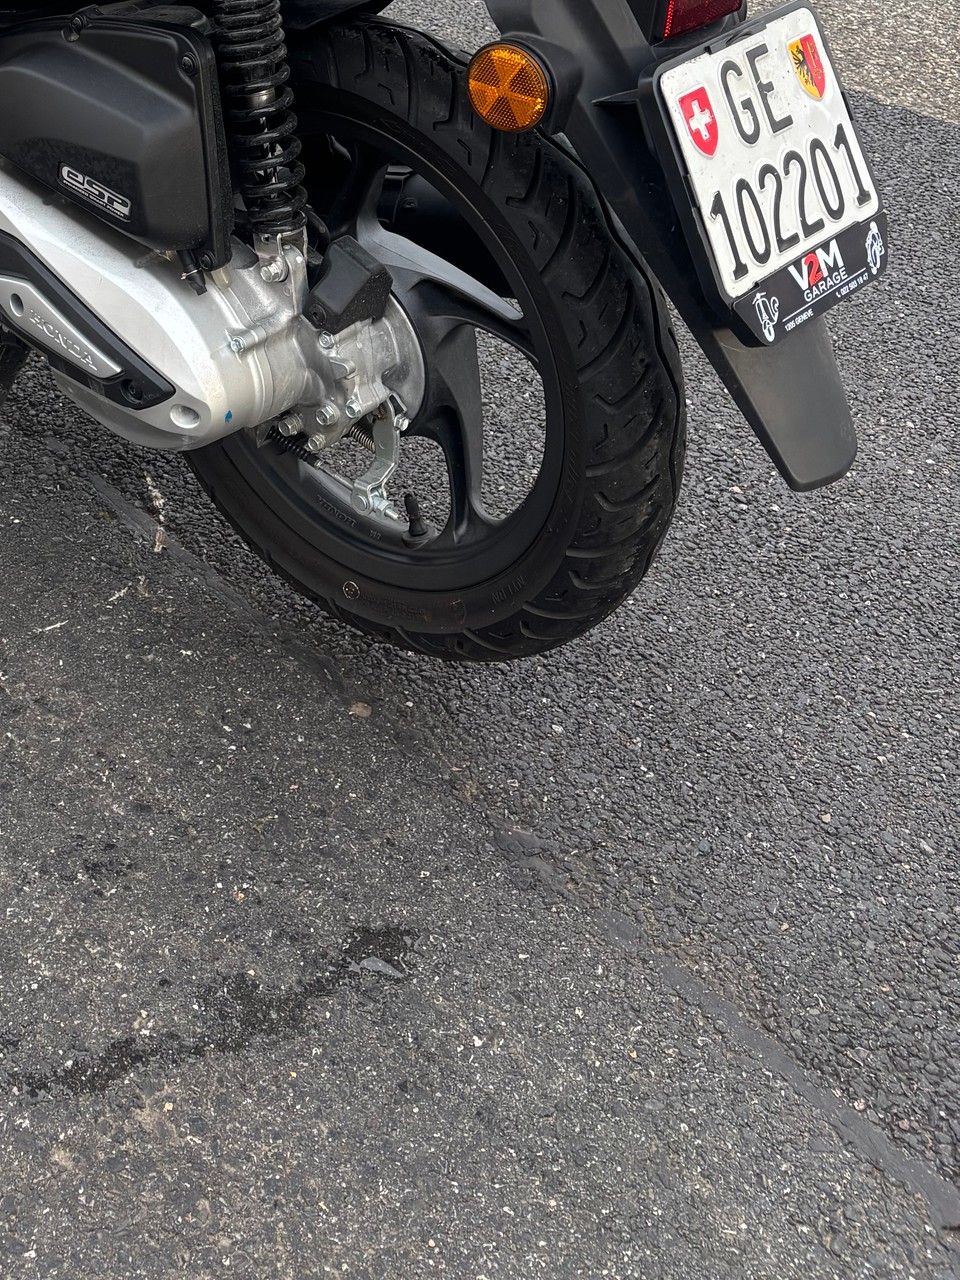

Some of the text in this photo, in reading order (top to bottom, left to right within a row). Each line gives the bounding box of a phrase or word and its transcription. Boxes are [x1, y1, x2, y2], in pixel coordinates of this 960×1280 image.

[720, 42, 794, 145] GE
[710, 123, 872, 281] 102201
[787, 238, 844, 291] V2M
[803, 267, 848, 302] GARAGE
[29, 309, 98, 371] HONDA
